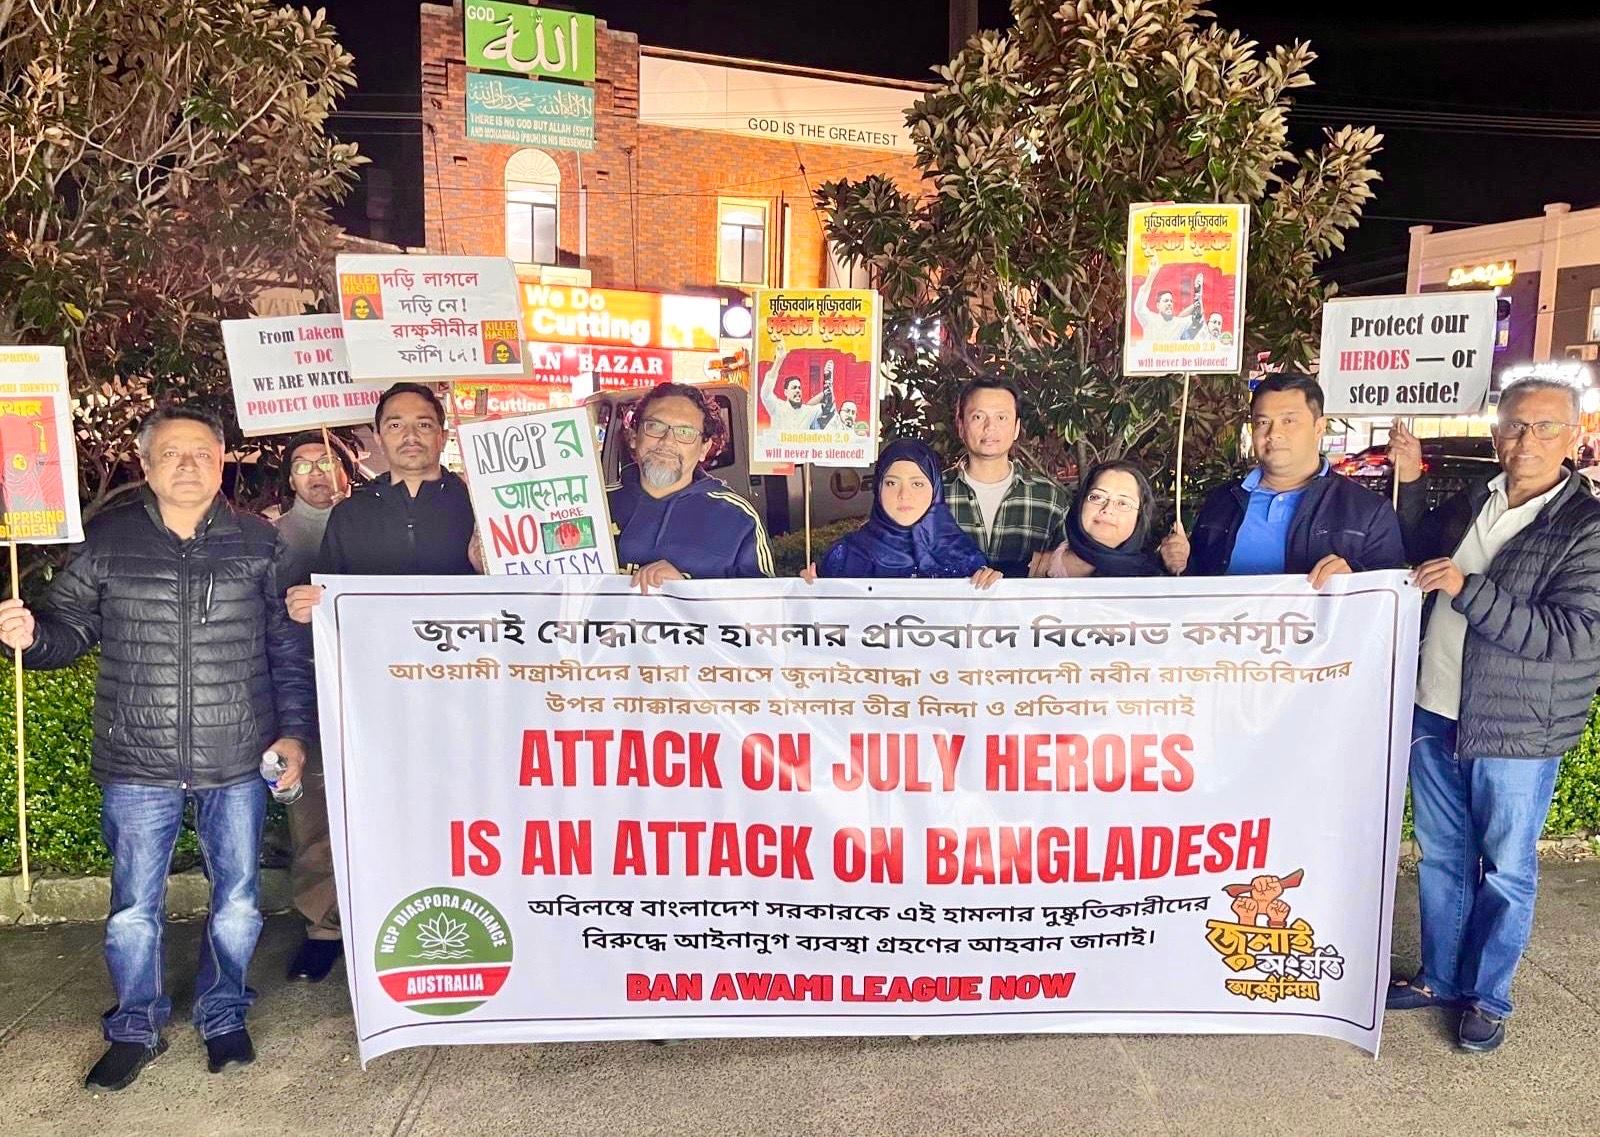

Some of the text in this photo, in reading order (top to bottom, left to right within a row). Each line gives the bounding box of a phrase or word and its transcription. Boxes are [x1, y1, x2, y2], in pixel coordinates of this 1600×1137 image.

[466, 5, 495, 22] GOD
[470, 112, 494, 126] THERE
[496, 116, 503, 126] IS
[504, 117, 514, 128] NO
[516, 118, 532, 130] GOD
[533, 120, 547, 131] BUT
[549, 122, 572, 134] ALLAH
[470, 126, 484, 137] AND
[748, 118, 898, 147] GOD IS THE GREATEST
[342, 274, 378, 284] KILLER
[423, 272, 478, 288] লাগলে
[526, 286, 604, 312] We Do
[485, 321, 518, 331] KILLER
[533, 310, 650, 347] Cutting
[1350, 313, 1470, 338] Protect our
[259, 330, 295, 345] From
[1152, 342, 1216, 352] Bangladesh 2.0
[294, 349, 333, 364] To DC
[578, 354, 664, 375] BAZAR
[1138, 358, 1228, 368] will never be silenced!
[1339, 349, 1411, 371] HEROES
[1452, 350, 1477, 369] or
[253, 377, 274, 392] WE
[278, 375, 304, 390] ARE
[1350, 382, 1460, 406] step aside!
[248, 396, 310, 416] PROTECT
[312, 394, 340, 412] OUR
[781, 432, 850, 443] Bangladesh 2.0
[766, 449, 864, 459] will never be silenced!
[550, 506, 585, 520] MORE
[489, 514, 539, 559] NO
[413, 610, 1316, 654] জুলাই যোদ্ধাদের হামলার প্রতিবাদে বিক্ষোভ কর্মসূচি
[388, 657, 500, 682] আওয়ামী
[638, 664, 690, 685] দ্বারা
[697, 664, 773, 684] প্রবাসে
[781, 660, 921, 688] জুলাইযোদ্ধা
[930, 669, 949, 686] ও
[958, 663, 1082, 686] বাংলাদেশী
[1090, 662, 1150, 686] নবীন
[1158, 660, 1353, 686] রাজনীতিবিদদের
[546, 693, 604, 714] উপর
[768, 698, 855, 717] হামলার
[863, 694, 910, 718] তীব্র
[918, 695, 978, 718] নিন্দা
[986, 701, 1005, 718] ও
[1013, 695, 1109, 719] প্রতিবাদ
[1116, 694, 1196, 718] জানাই
[519, 730, 1195, 794] ATTACK ON JULY HEROES
[450, 817, 1271, 885] IS AN ATTACK ON BANGLADESH
[528, 894, 634, 918] অবিলম্বে
[640, 899, 759, 918] বাংলাদেশ
[766, 902, 890, 922] সরকারকে
[897, 902, 939, 924] এই
[943, 905, 1034, 924] হামলার
[380, 894, 507, 954] NCP DIASPORA ALLIANCE
[582, 927, 667, 952] বিরুদ্ধে
[674, 928, 790, 954] আইনানুগ
[796, 935, 869, 954] ব্যবস্থা
[876, 936, 960, 954] গ্রহণের
[1205, 918, 1315, 972] জুলাই
[1256, 945, 1344, 980] সংহতি
[407, 974, 484, 995] AUSTRALIA
[626, 972, 1076, 1002] BAN AWAMI LEAGUE NOW
